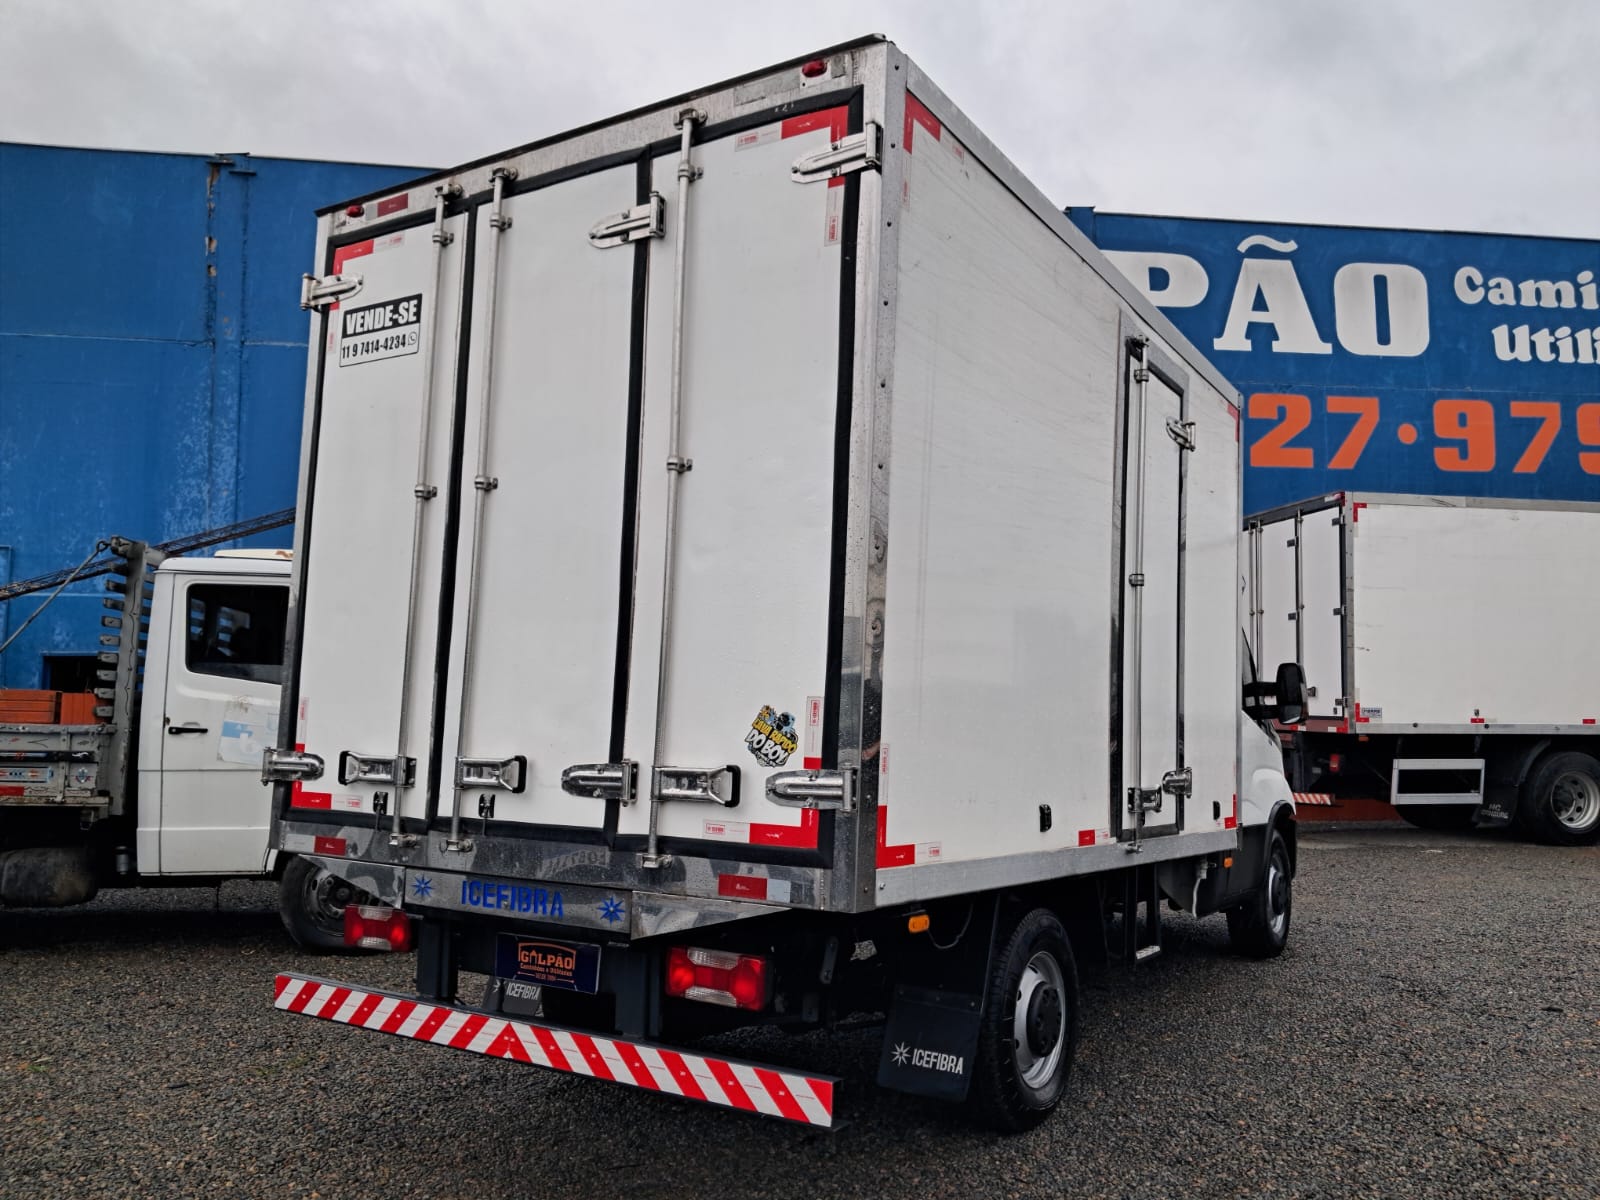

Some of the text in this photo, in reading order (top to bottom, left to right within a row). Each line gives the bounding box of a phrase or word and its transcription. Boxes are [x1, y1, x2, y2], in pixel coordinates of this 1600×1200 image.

[1454, 266, 1600, 310] Cami
[346, 300, 418, 335] VENDE-SE
[342, 334, 406, 359] 11 9 7414-4234
[744, 728, 790, 765] DO BOY
[461, 880, 564, 917] ICEFIBRA
[506, 982, 540, 999] ICEFIBRA
[912, 1048, 964, 1074] ICEFIBRA
